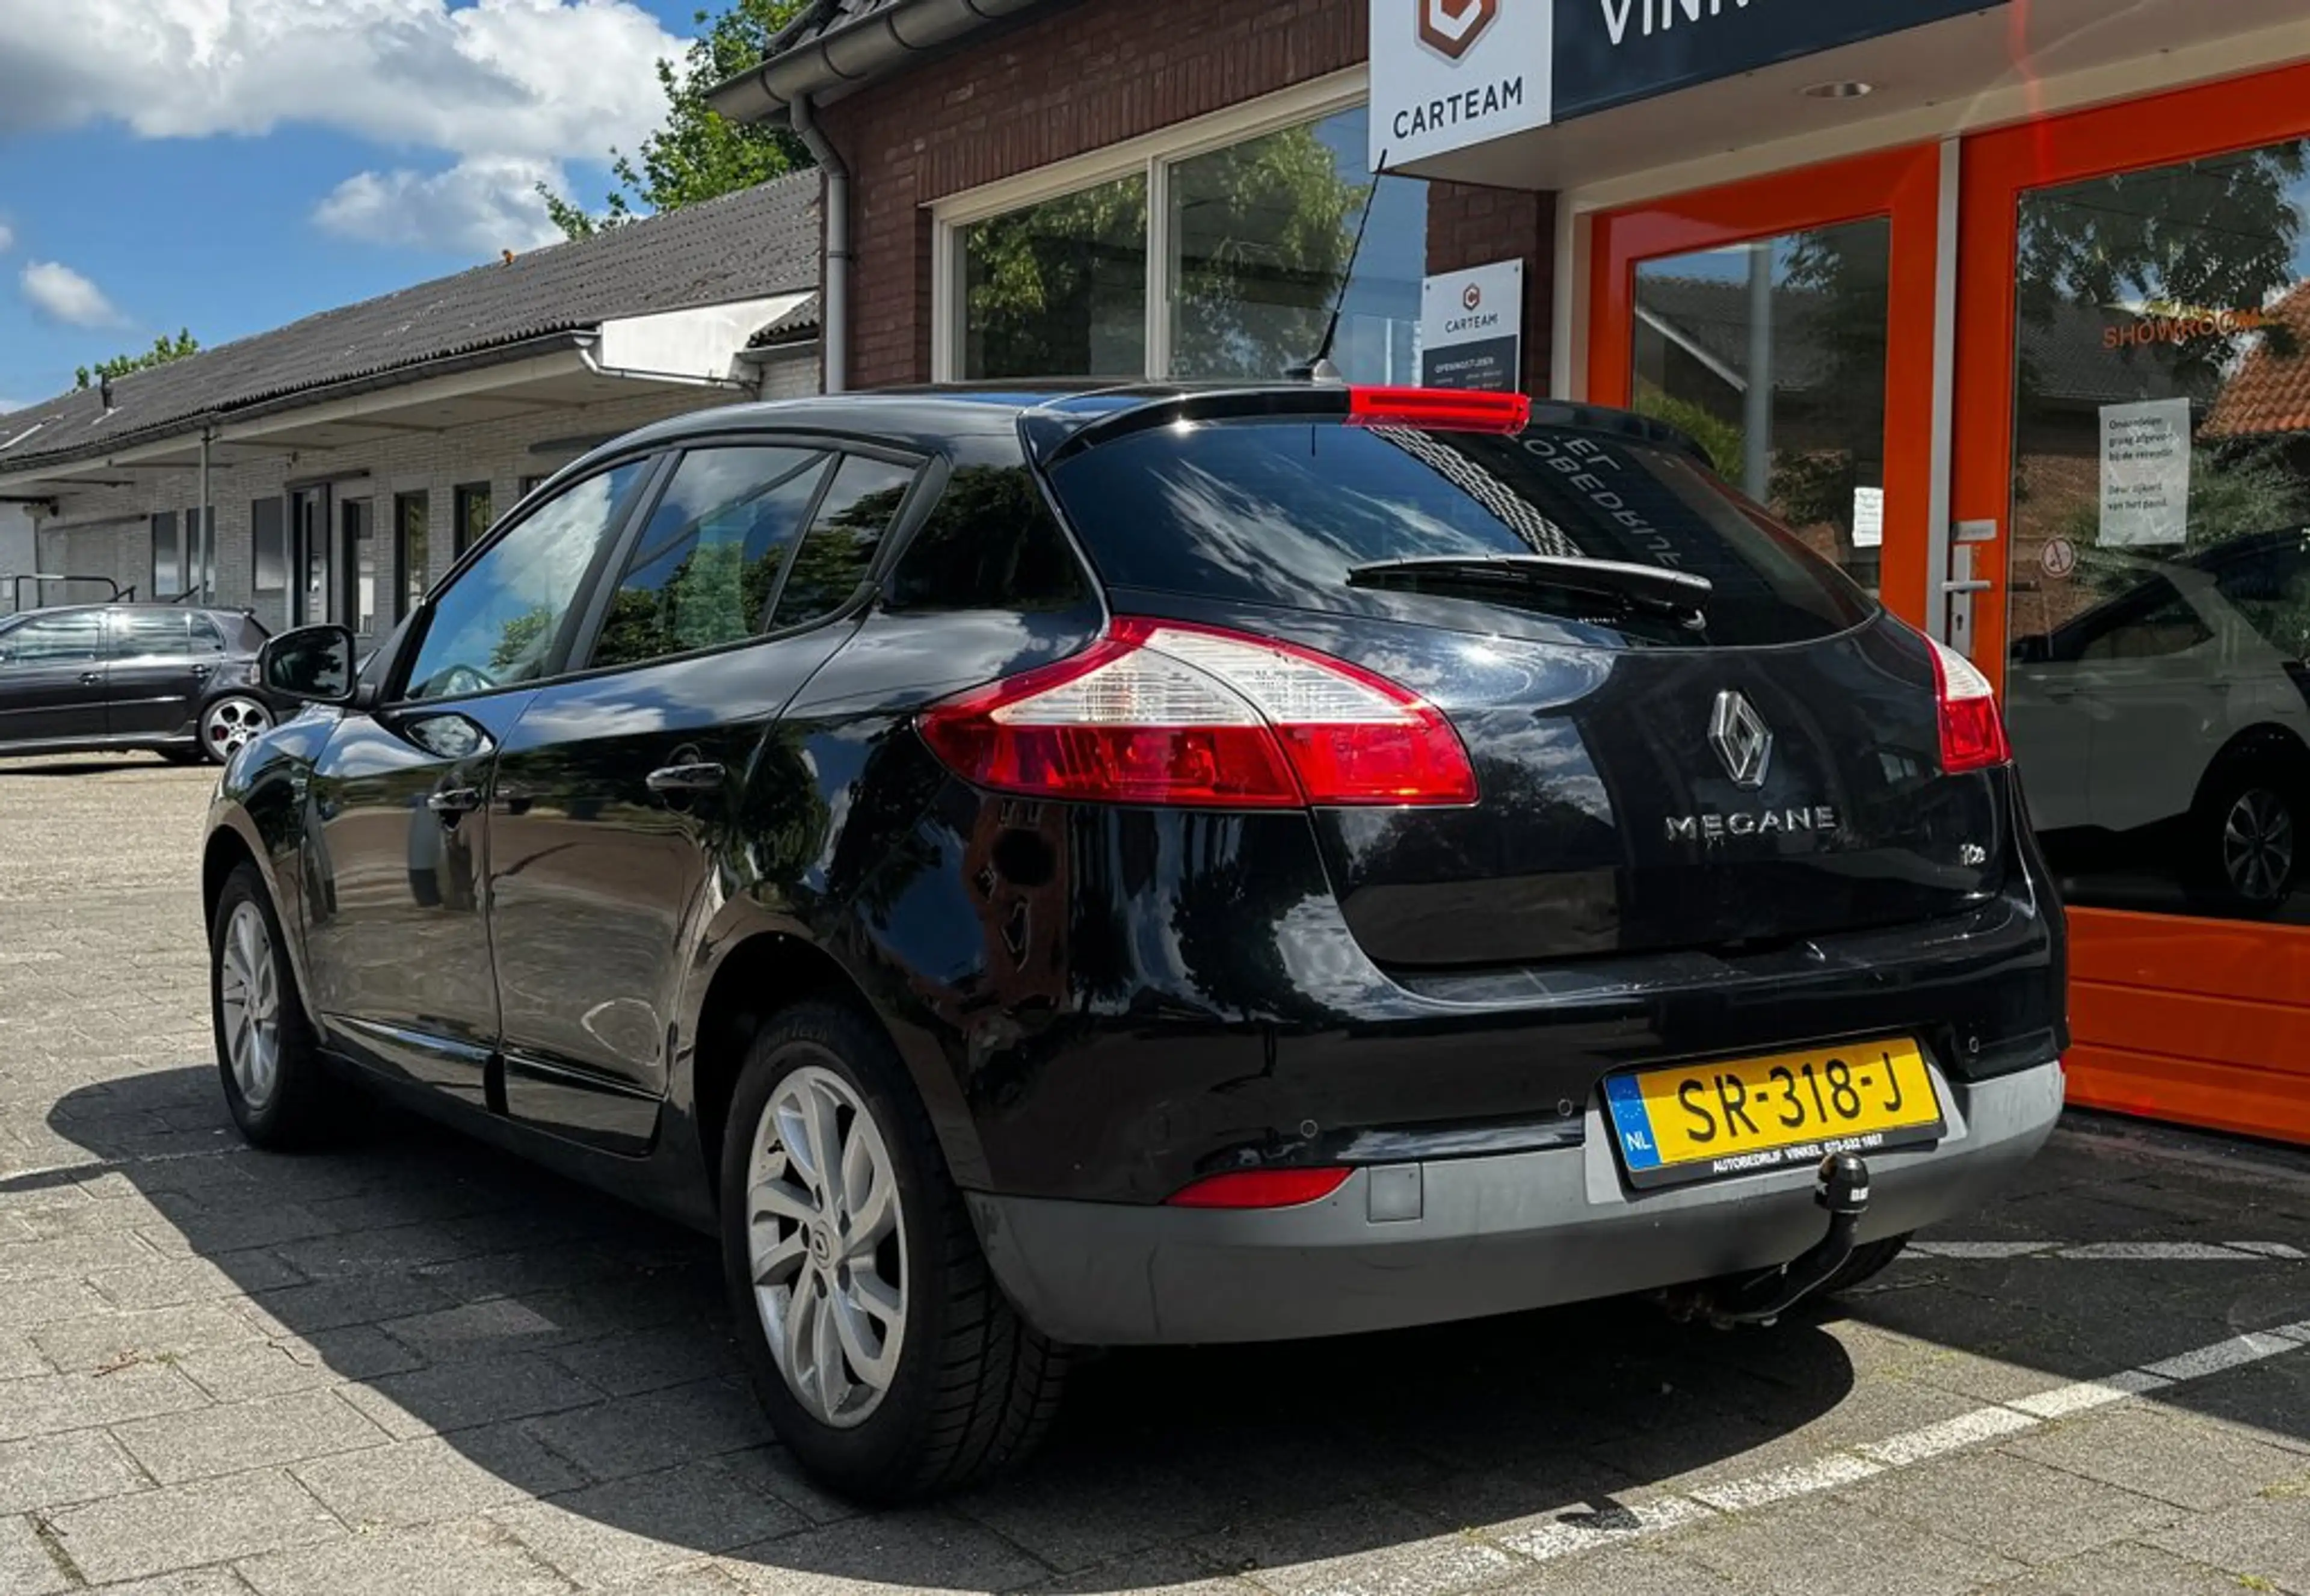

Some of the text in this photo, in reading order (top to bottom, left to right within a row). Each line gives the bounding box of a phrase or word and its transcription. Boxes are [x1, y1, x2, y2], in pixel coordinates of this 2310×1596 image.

[1393, 76, 1523, 139] CARTEAM
[1445, 313, 1498, 333] CARTEAM
[2103, 309, 2259, 348] SHOWROOM
[1666, 806, 1837, 840] MEGANE
[1678, 1052, 1903, 1143] SR-318-J
[1625, 1129, 1652, 1152] NL
[1713, 1151, 1782, 1173] AUTOBEDRIJF
[1785, 1144, 1823, 1160] VINKEL
